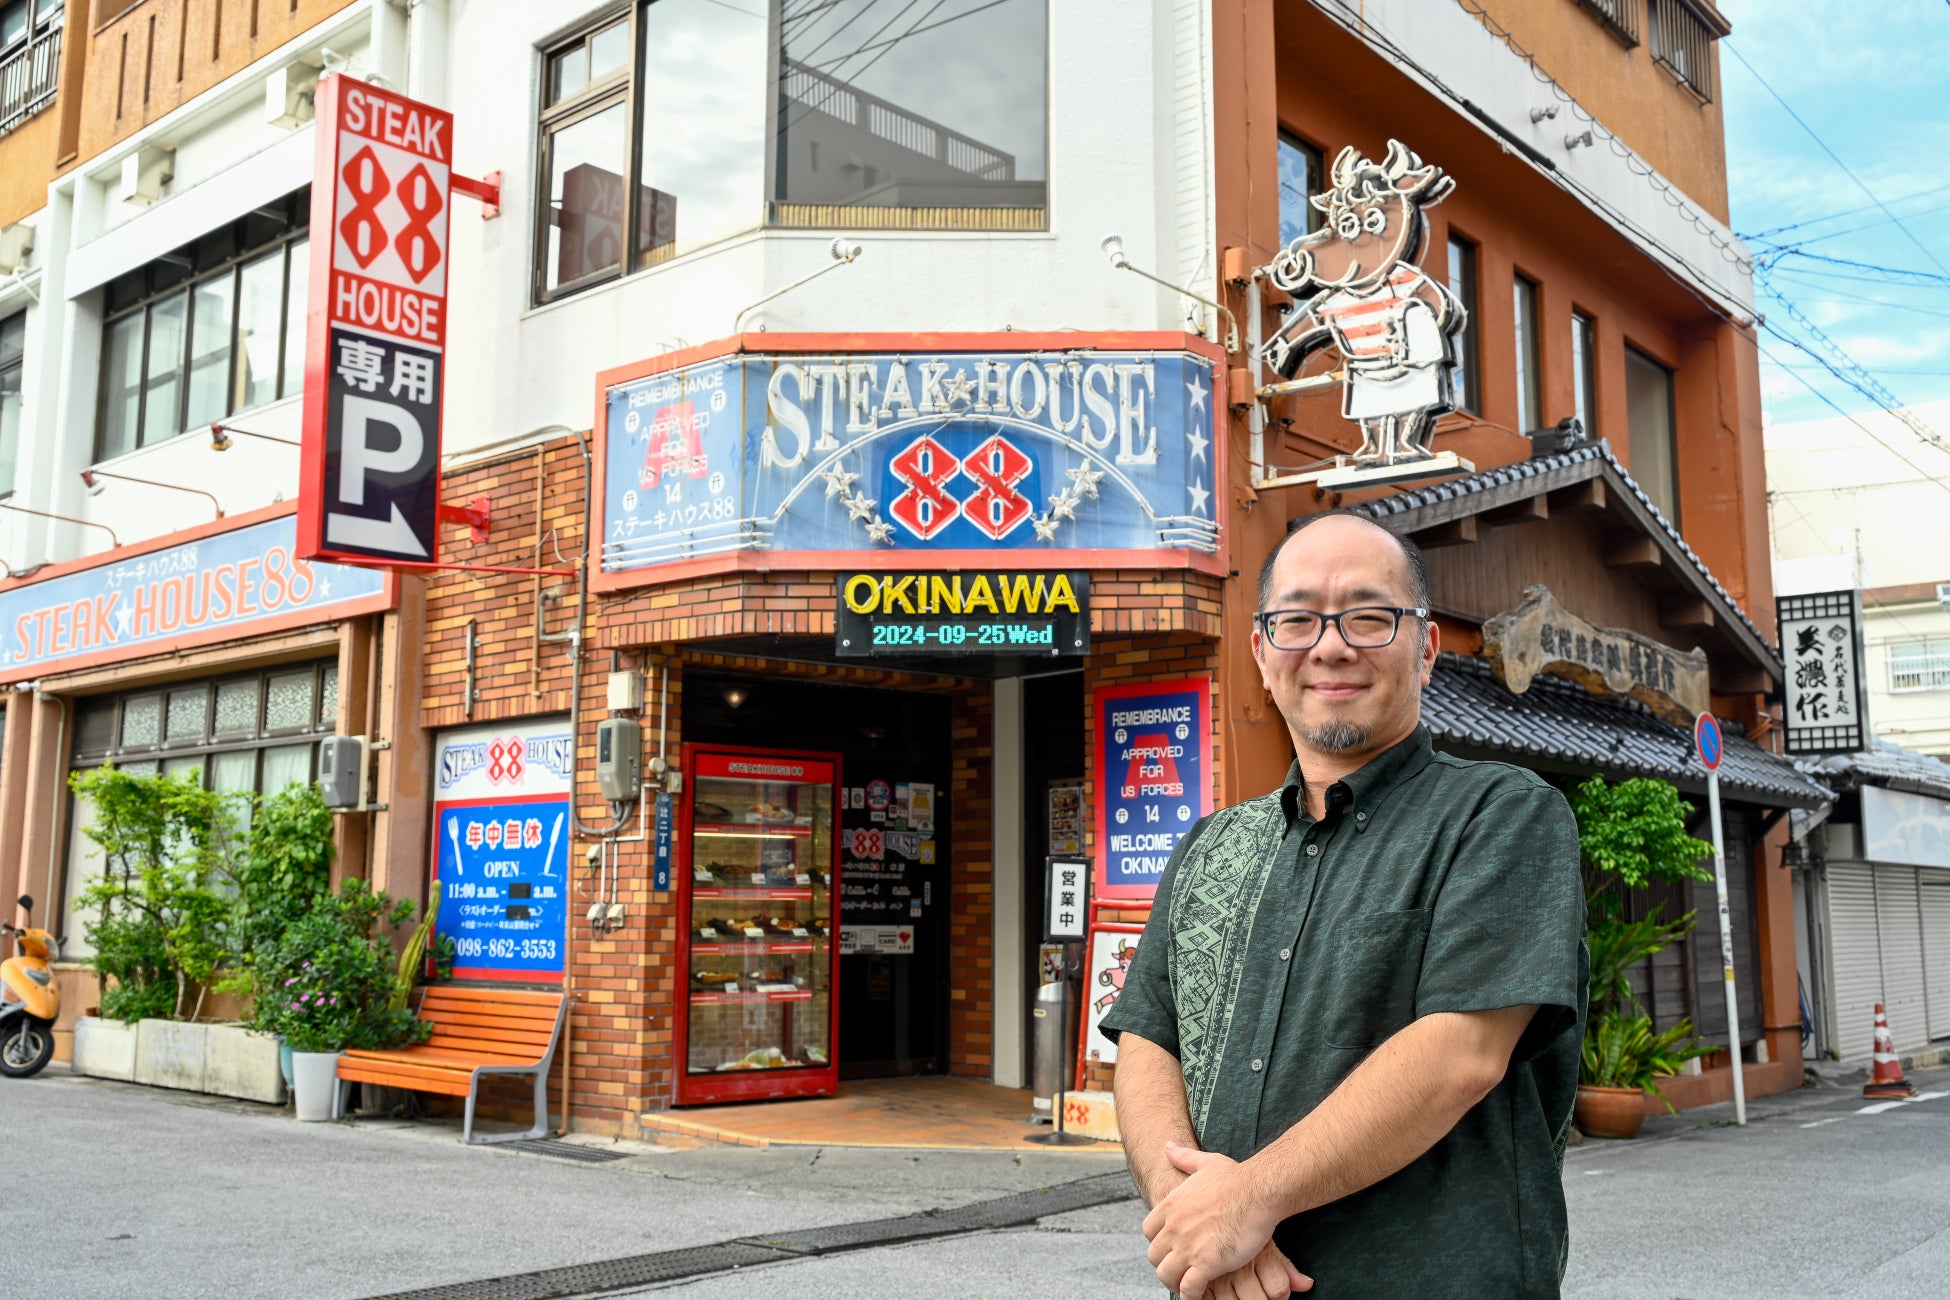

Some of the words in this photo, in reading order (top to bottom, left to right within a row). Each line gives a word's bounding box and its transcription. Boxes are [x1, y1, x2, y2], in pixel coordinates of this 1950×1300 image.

[345, 88, 444, 160] STEAK
[339, 144, 444, 285] 88
[336, 275, 439, 341] HOUSE
[337, 338, 434, 405] 専用
[628, 370, 724, 410] REMEMBRANCE
[763, 362, 951, 469] STEAK
[974, 361, 1158, 465] HOUSE
[339, 393, 424, 506] P
[663, 482, 683, 505] 14
[889, 434, 1034, 542] 88
[612, 495, 735, 538] ステーキハウス88
[104, 546, 199, 590] ステーキハウス88
[844, 573, 1081, 615] OKINAWA
[15, 591, 122, 661] STEAK
[1112, 706, 1191, 728] REMEMBRANCE
[442, 746, 487, 785] STEAK
[488, 740, 524, 784] 88
[528, 738, 572, 774] HOUSE
[728, 761, 791, 776] STEAKHOUSE
[1121, 745, 1184, 762] APPROVED
[1139, 764, 1165, 779] FOR
[1120, 785, 1136, 798] US
[1140, 782, 1184, 797] FORCES
[1144, 804, 1160, 823] 14
[466, 817, 543, 852] 年中無休
[853, 831, 882, 858] 88
[1110, 833, 1174, 853] WELCOME
[483, 860, 520, 878] OPEN
[658, 871, 667, 885] 8
[1121, 855, 1171, 875] OKINA
[448, 882, 476, 899] 11:00
[477, 886, 500, 899] a.m.
[533, 886, 557, 899] a.m.
[1059, 870, 1077, 928] 営業中
[457, 937, 556, 960] 098-862-3553
